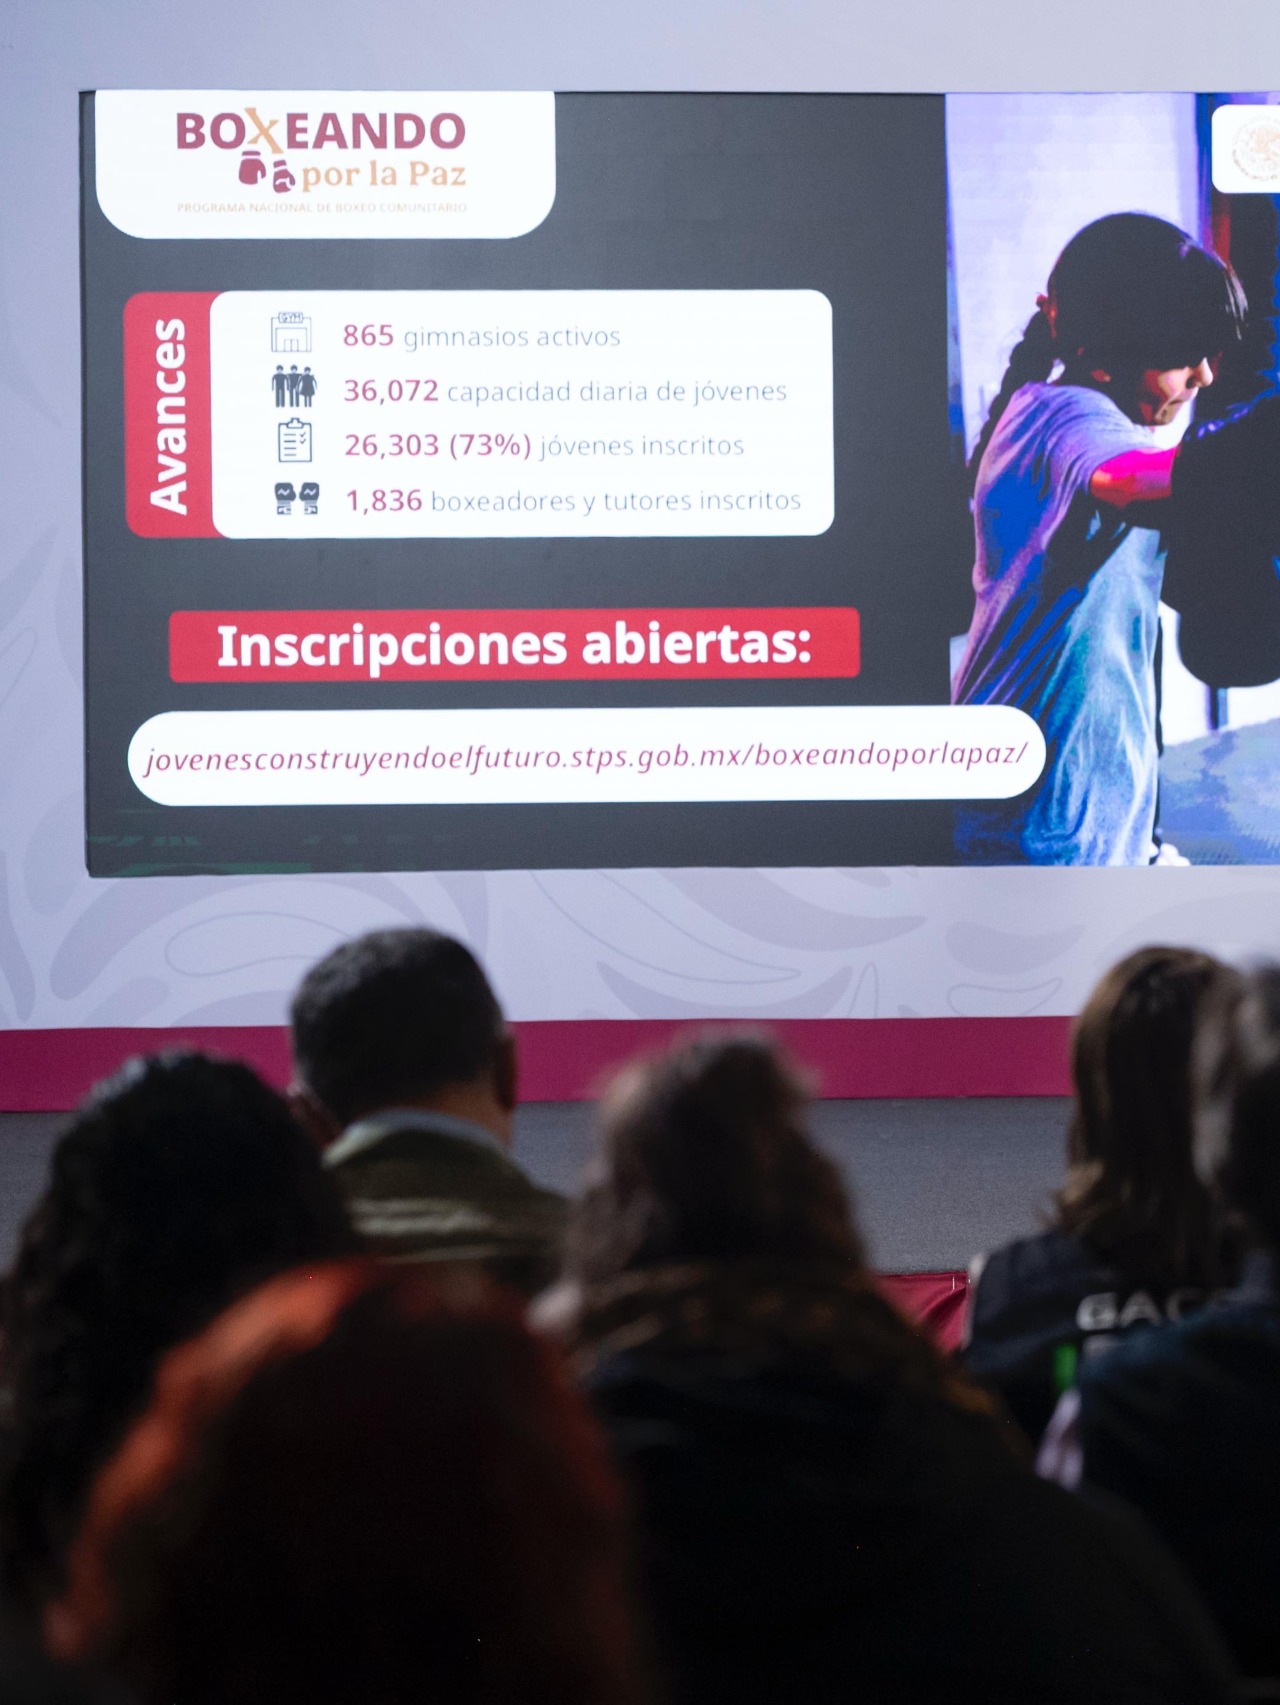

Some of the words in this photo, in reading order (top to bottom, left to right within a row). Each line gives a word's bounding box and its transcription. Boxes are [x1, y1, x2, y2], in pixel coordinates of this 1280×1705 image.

[177, 108, 465, 154] BOXEANDO
[303, 167, 360, 192] por
[371, 160, 396, 185] la
[410, 161, 465, 185] Paz
[177, 202, 247, 213] PROGRAMA
[249, 202, 313, 213] NACIONAL
[316, 203, 332, 213] DE
[335, 203, 377, 213] BOXEO
[380, 203, 468, 213] COMUNITARIO
[344, 324, 393, 346] 865
[404, 326, 529, 353] gimnasios
[537, 326, 621, 346] activos
[345, 380, 438, 405] 36,072
[448, 381, 569, 406] capacidad
[580, 381, 646, 400] diaria
[657, 381, 685, 400] de
[695, 381, 786, 406] jóvenes
[151, 319, 186, 515] Avances
[346, 434, 438, 459] 26,303
[450, 434, 530, 460] (73%)
[540, 436, 633, 461] jóvenes
[642, 435, 745, 455] inscritos
[347, 489, 422, 515] 1,836
[432, 490, 576, 512] boxeadores
[583, 496, 597, 518] y
[604, 493, 692, 511] tutores
[700, 490, 802, 511] inscritos
[218, 623, 566, 677] Inscripciones
[583, 621, 810, 663] abiertas:
[144, 743, 1026, 777] jovenesconstruyendoelfuturo.stps.gob.mx/boxeandoporlapaz/
